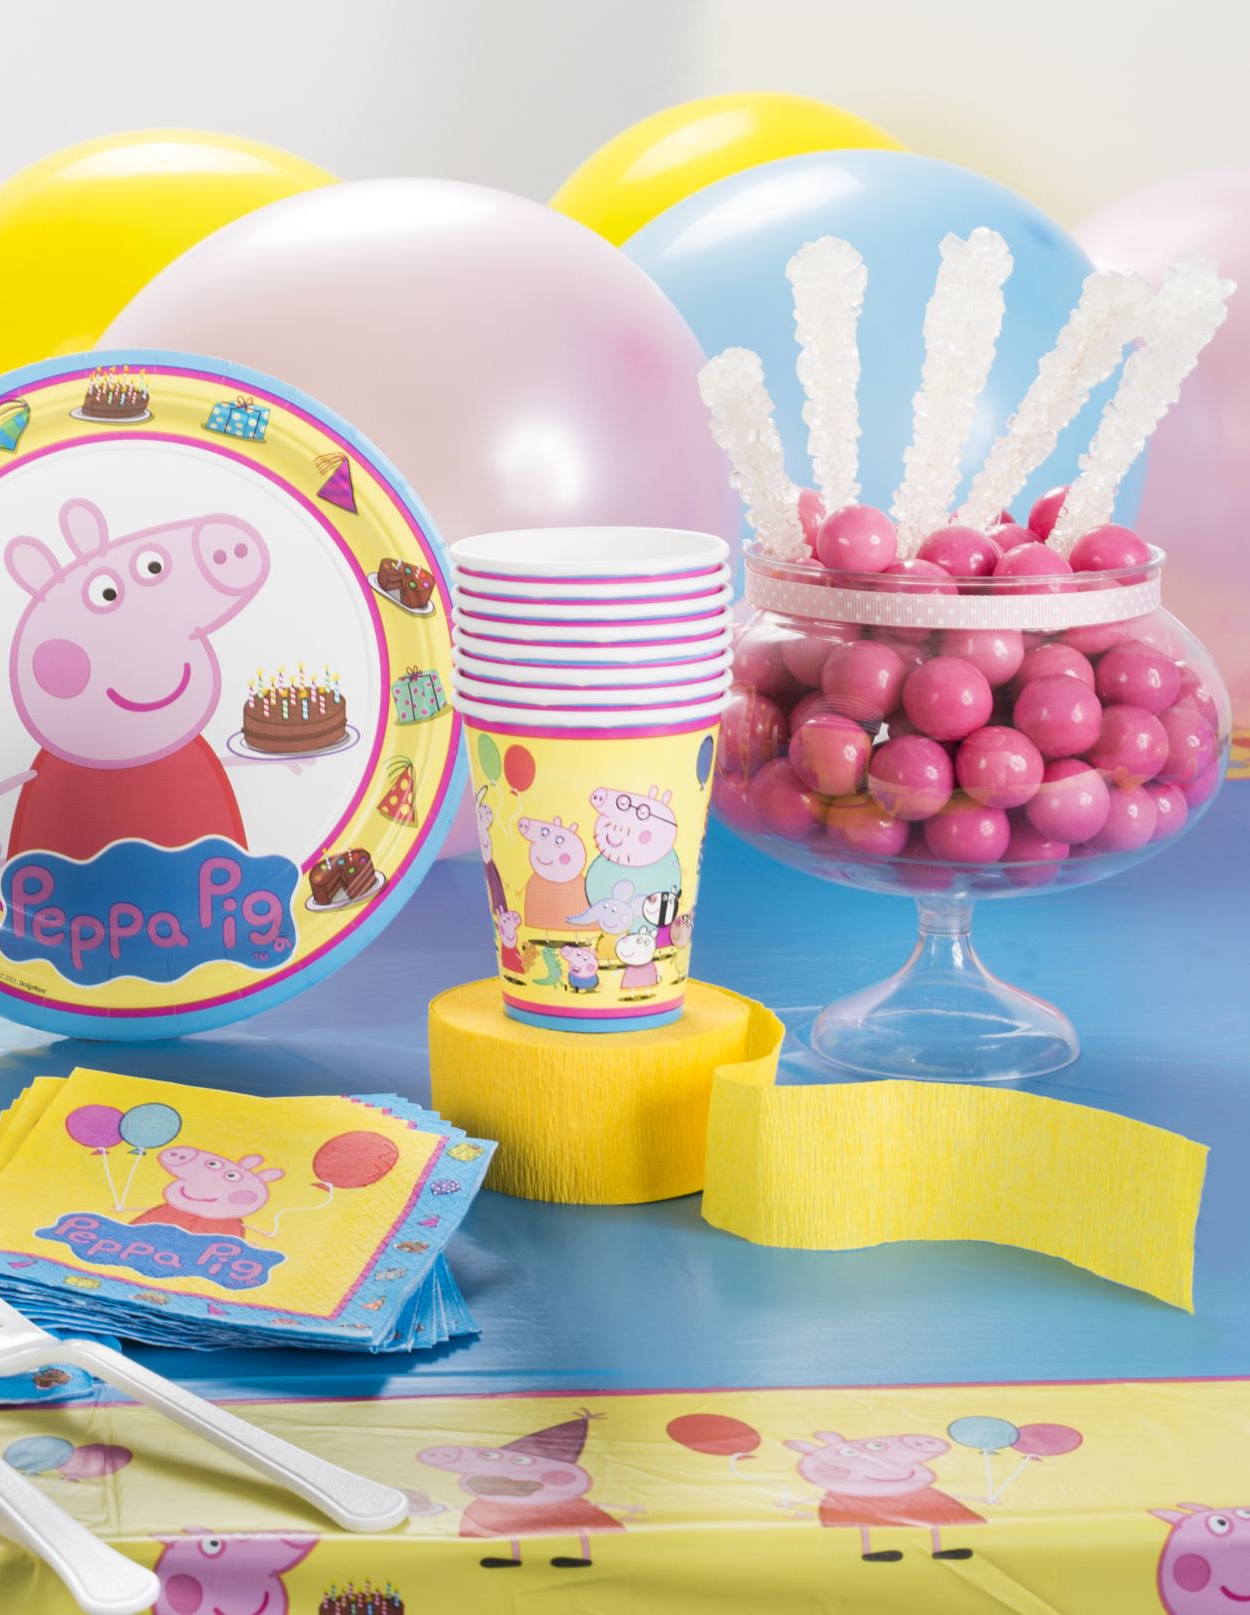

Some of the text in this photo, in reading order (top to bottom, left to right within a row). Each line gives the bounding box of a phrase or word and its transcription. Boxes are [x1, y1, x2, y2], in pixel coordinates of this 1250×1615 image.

[10, 864, 190, 971] Peppa
[199, 856, 293, 953] Pig
[53, 1215, 263, 1287] Peppa Pig
